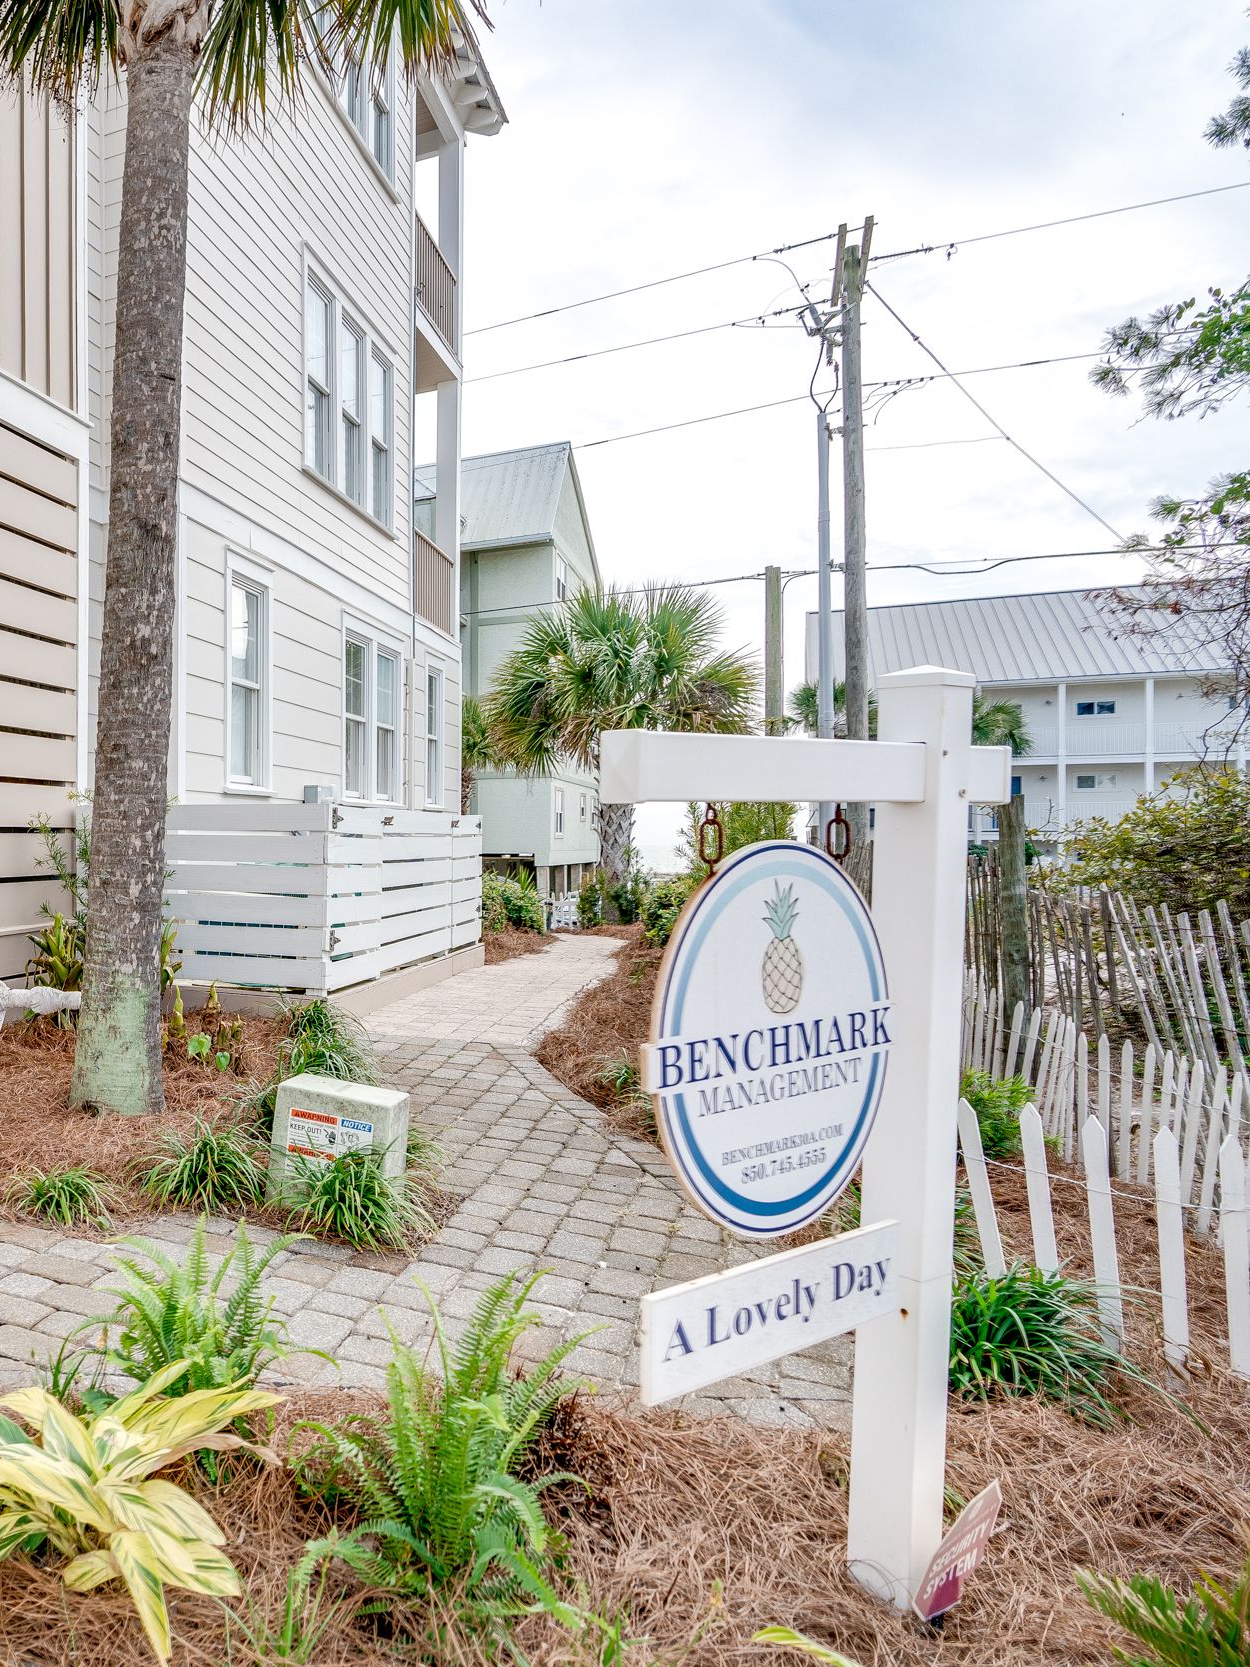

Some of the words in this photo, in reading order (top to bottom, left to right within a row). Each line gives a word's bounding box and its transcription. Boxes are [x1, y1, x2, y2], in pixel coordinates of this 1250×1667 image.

[656, 1006, 892, 1090] BENCHMARK
[697, 1056, 862, 1118] MANAGEMENT
[290, 1123, 306, 1131] KEEP
[306, 1126, 322, 1136] OUT!
[299, 1110, 336, 1124] WARNING
[342, 1120, 370, 1132] NOTICE
[720, 1123, 844, 1166] BENCHMARK30A.COM
[740, 1147, 827, 1184] 850.745.4555
[661, 1317, 695, 1363] A
[703, 1278, 821, 1348] Lovely
[830, 1257, 891, 1302] Day
[928, 1518, 991, 1579] SECURITY
[923, 1548, 978, 1600] SYSTEM
